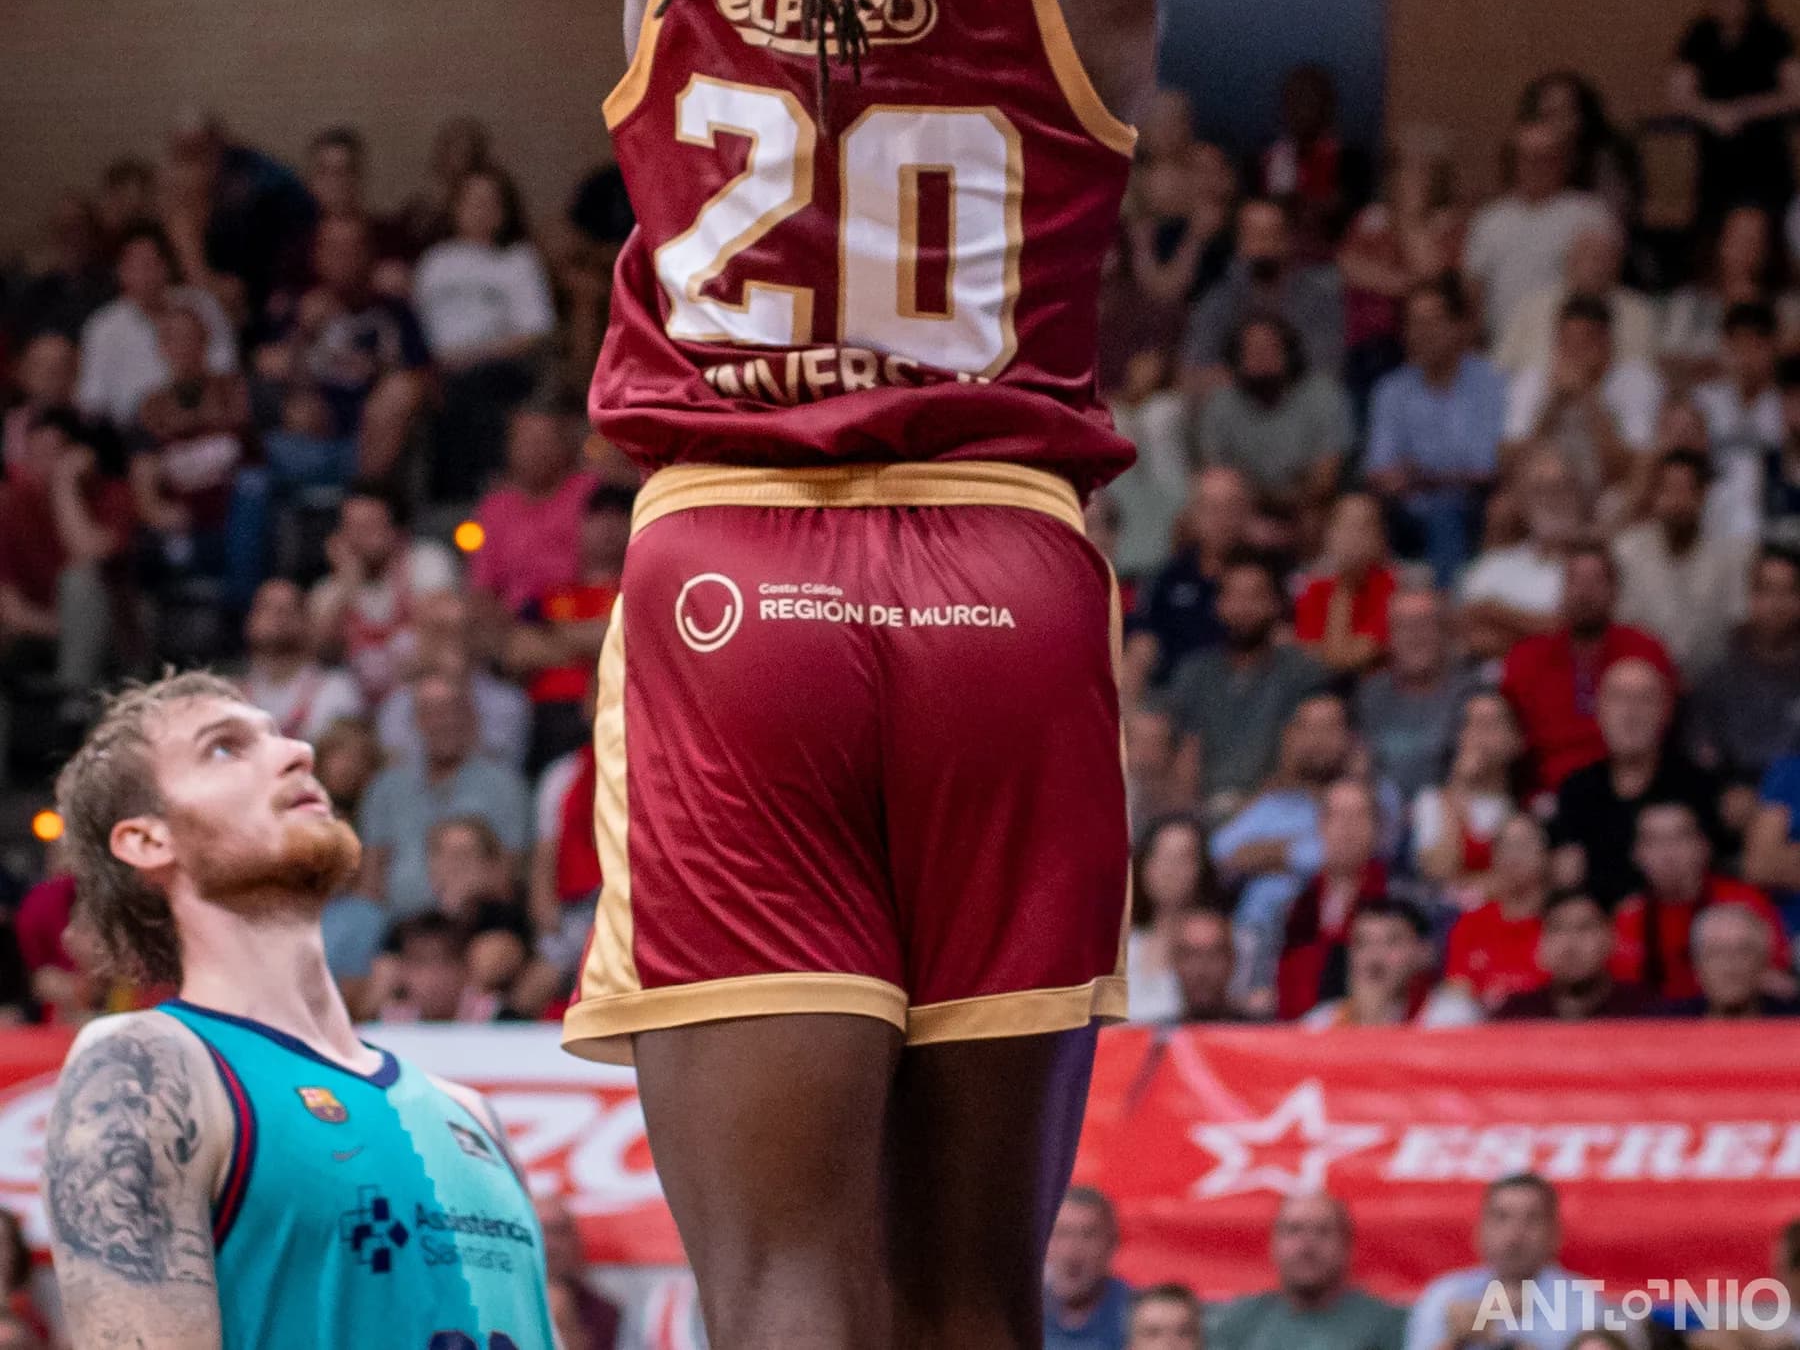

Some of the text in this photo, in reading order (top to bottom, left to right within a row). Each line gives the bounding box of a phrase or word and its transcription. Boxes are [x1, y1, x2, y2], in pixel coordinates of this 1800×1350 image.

[654, 72, 1024, 380] 20
[760, 598, 1016, 628] REGIÓN DE MURCIA
